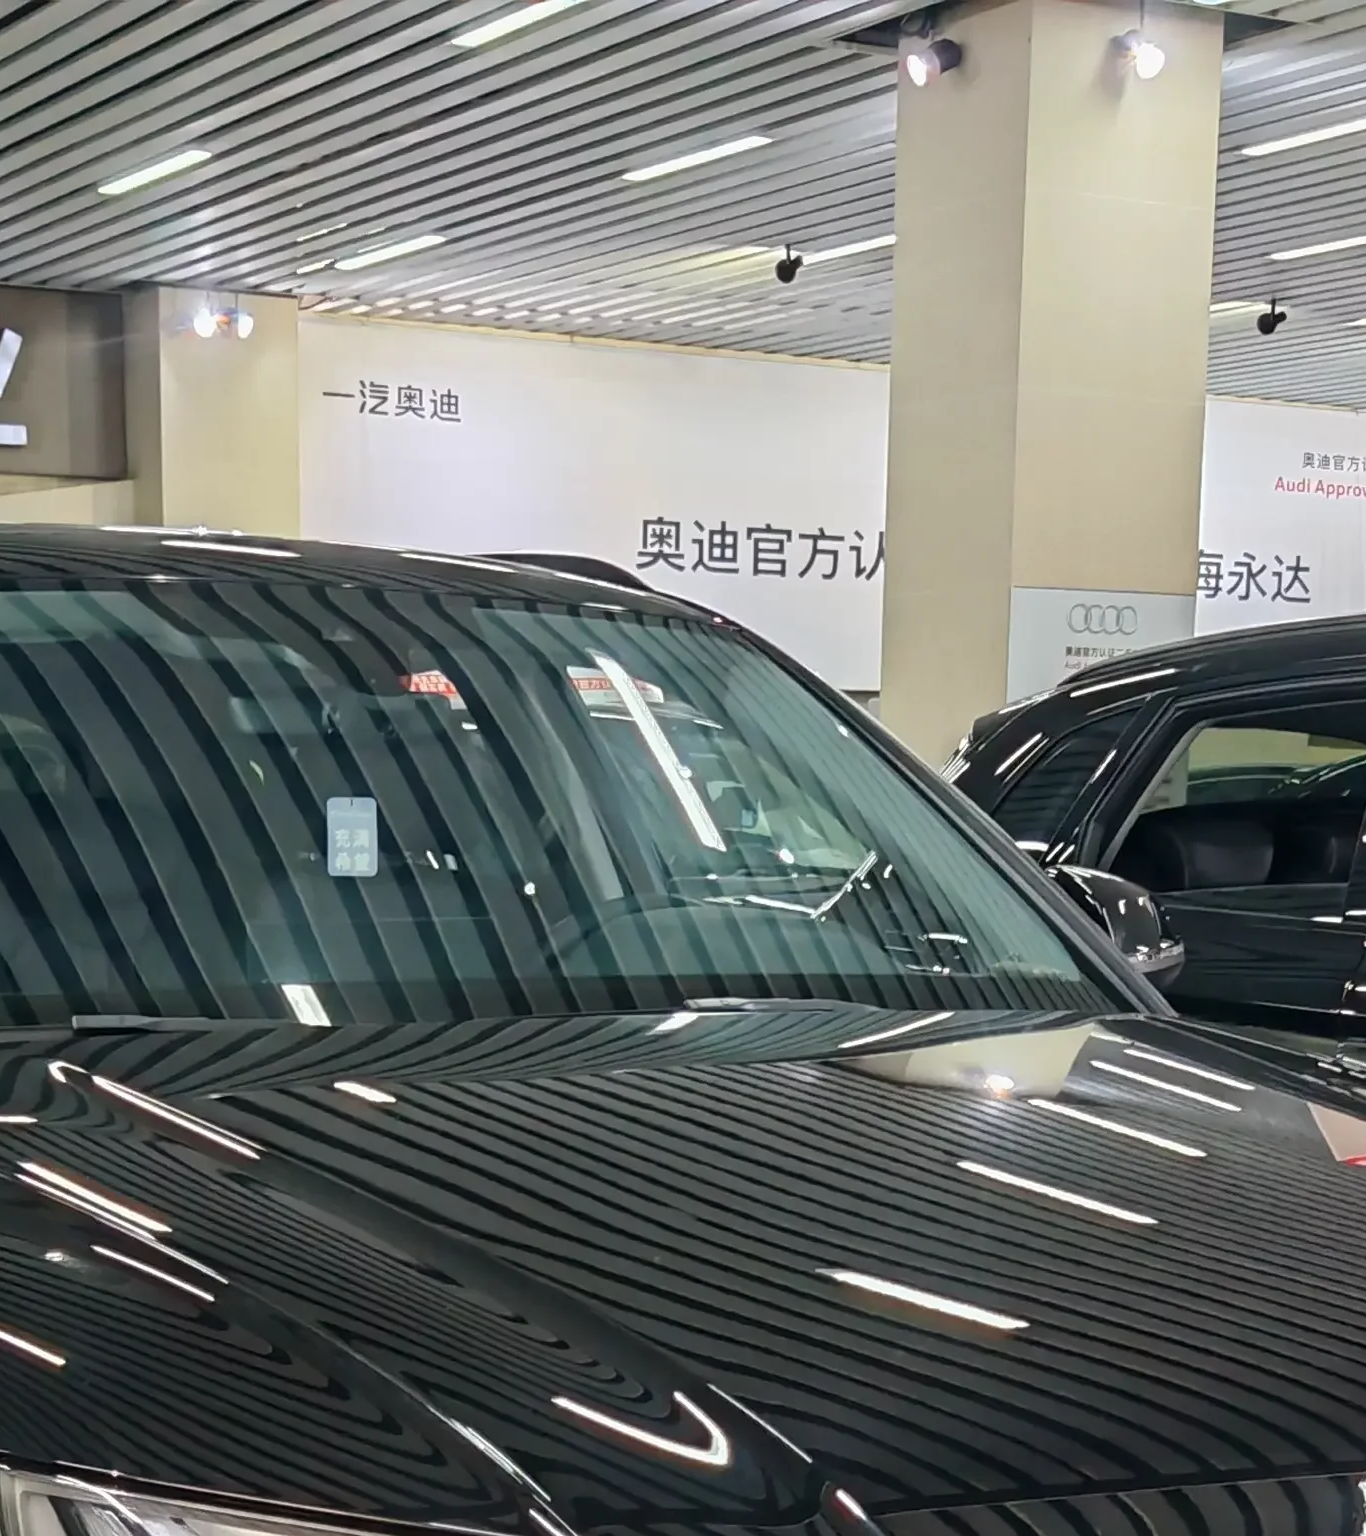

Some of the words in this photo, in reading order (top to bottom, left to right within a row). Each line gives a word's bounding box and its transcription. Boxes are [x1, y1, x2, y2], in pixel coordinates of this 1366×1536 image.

[322, 379, 462, 423] 一汽奥迪
[1274, 475, 1311, 494] Audi
[635, 515, 886, 582] 奥迪官方认
